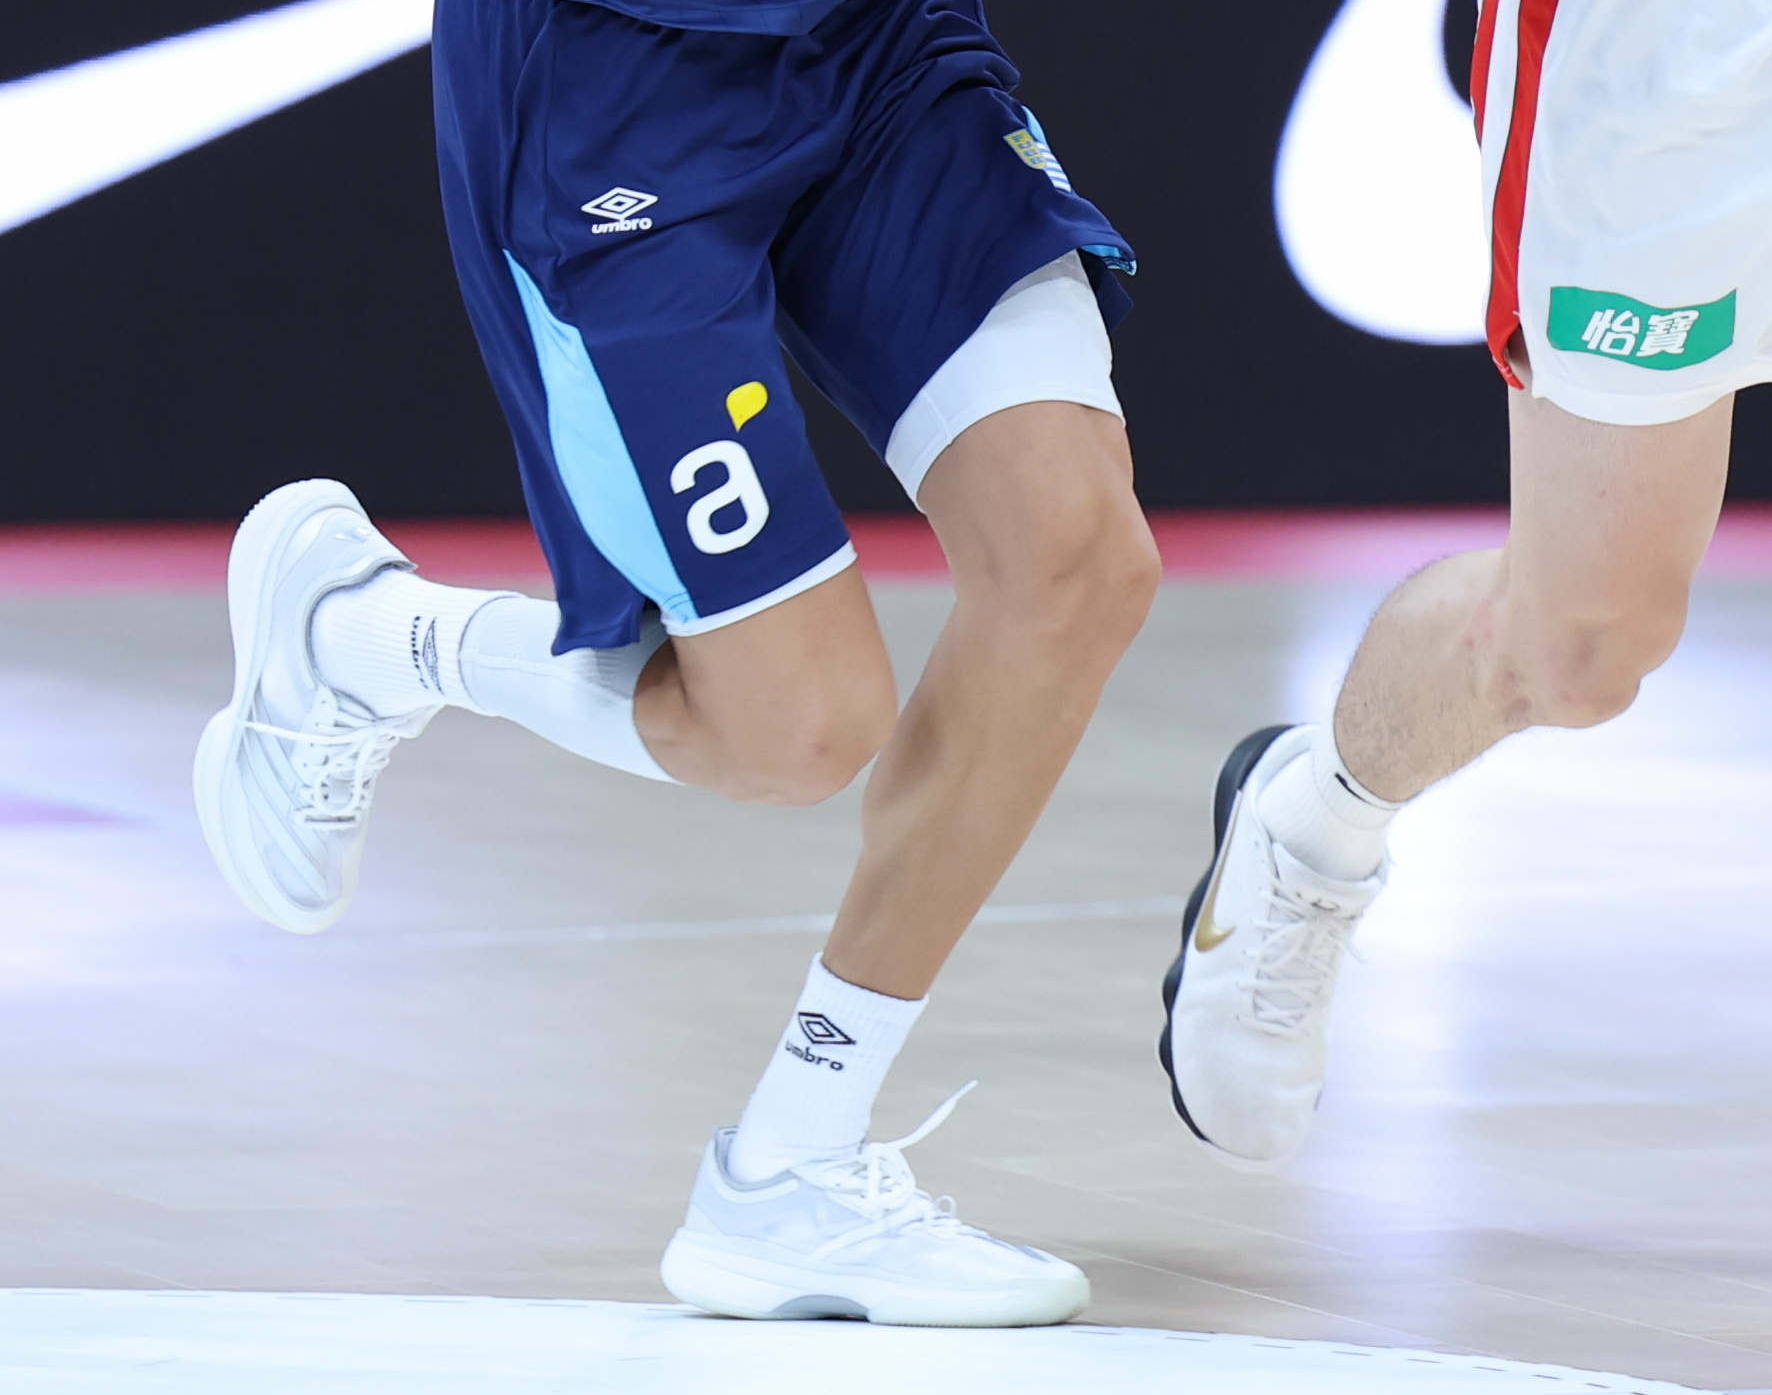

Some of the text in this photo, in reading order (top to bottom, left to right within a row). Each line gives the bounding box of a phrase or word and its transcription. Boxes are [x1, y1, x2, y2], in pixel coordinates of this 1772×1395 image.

[591, 215, 653, 234] umbro
[1581, 308, 1700, 357] 怡寶
[784, 1040, 845, 1071] umbro
